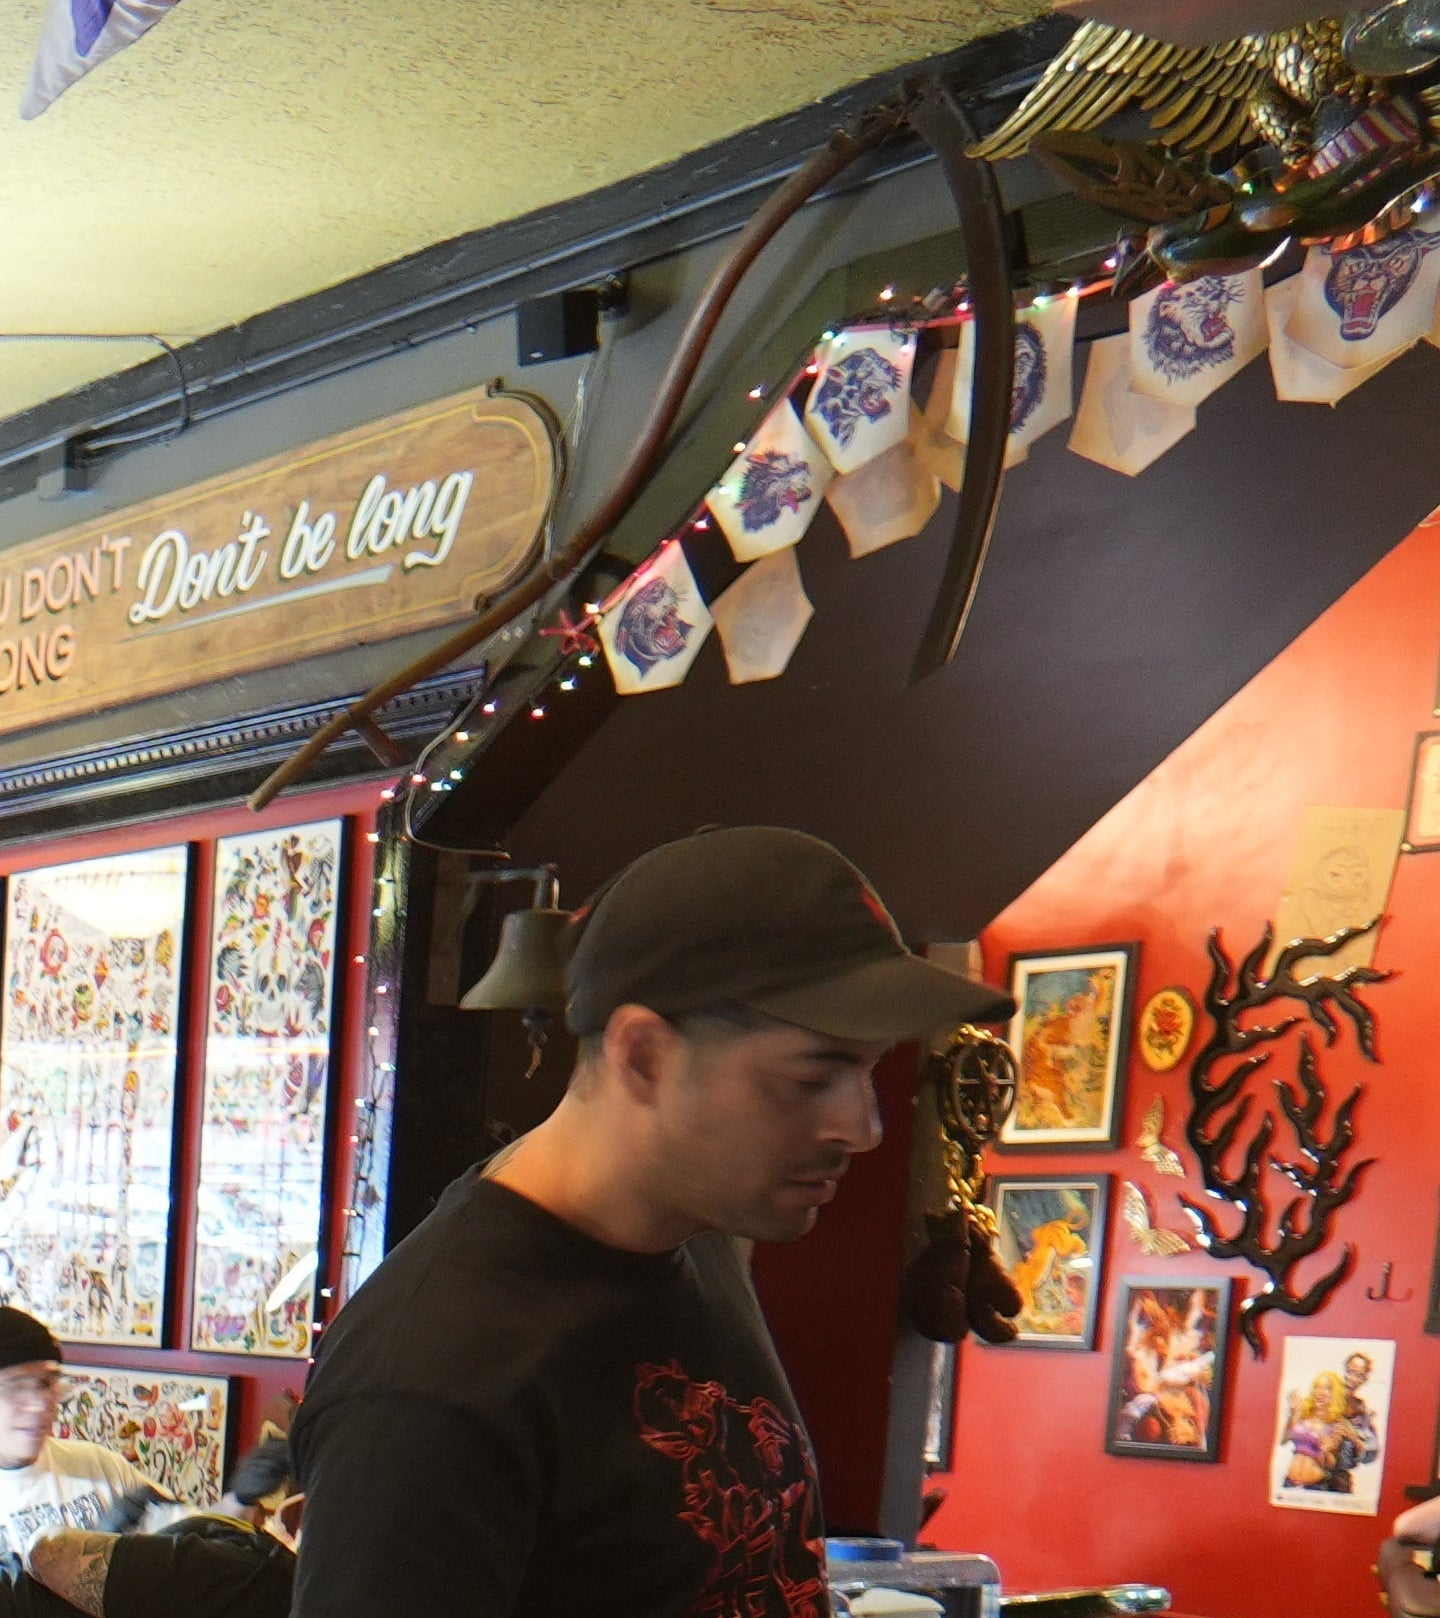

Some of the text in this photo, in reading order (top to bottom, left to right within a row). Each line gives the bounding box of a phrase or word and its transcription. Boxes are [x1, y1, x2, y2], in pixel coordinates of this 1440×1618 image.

[20, 534, 134, 624] DON'T
[129, 470, 475, 625] Don't be long
